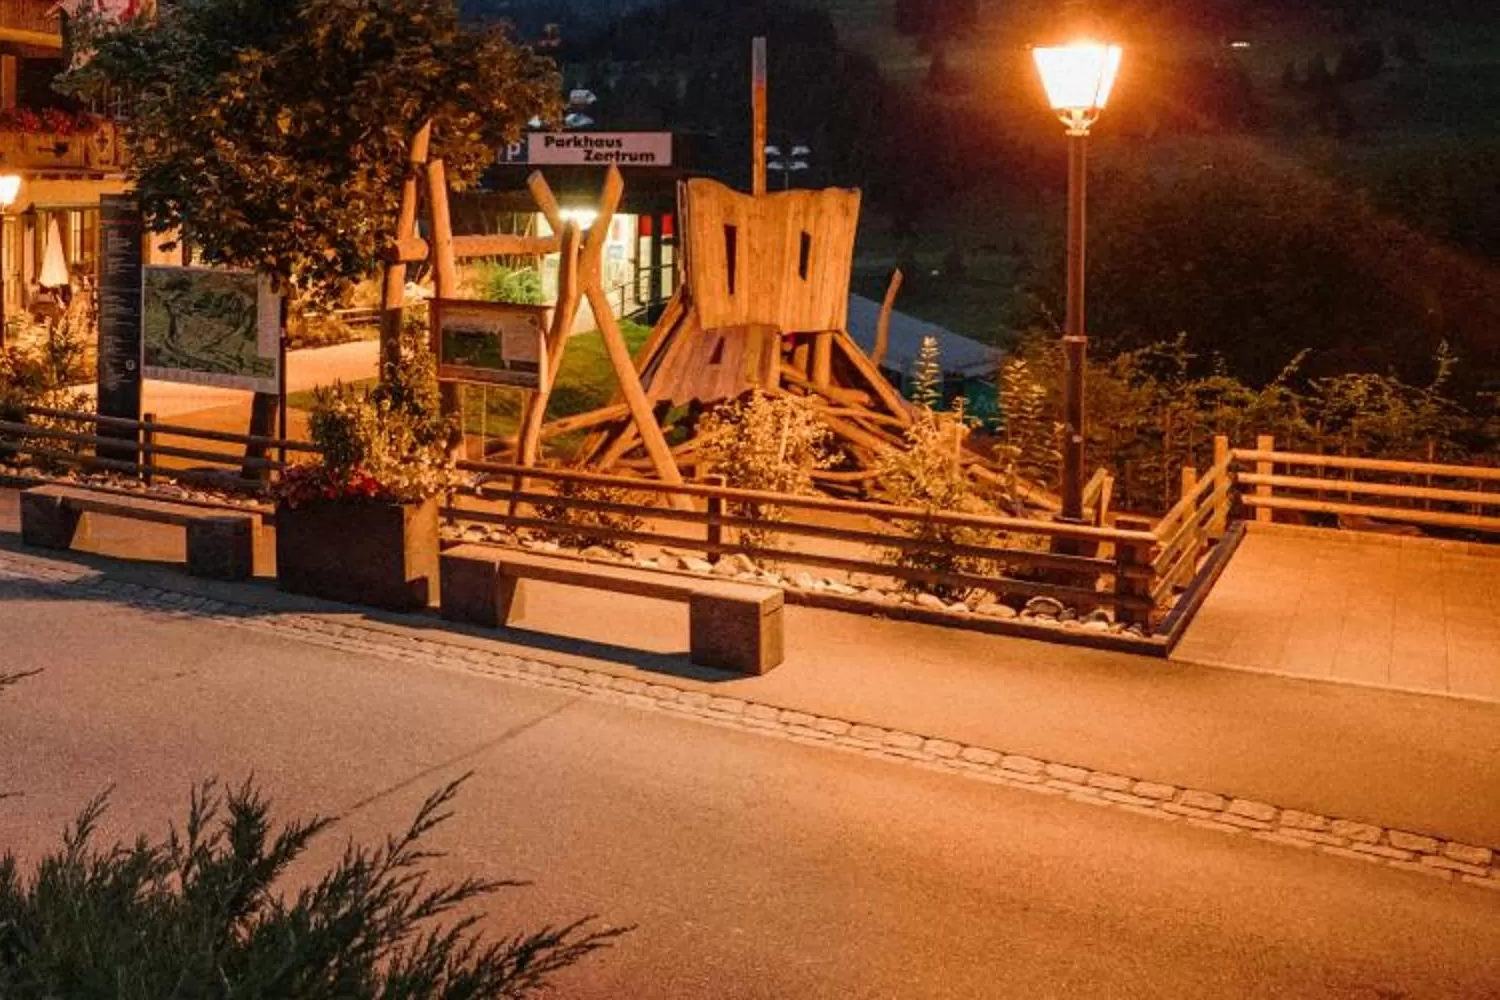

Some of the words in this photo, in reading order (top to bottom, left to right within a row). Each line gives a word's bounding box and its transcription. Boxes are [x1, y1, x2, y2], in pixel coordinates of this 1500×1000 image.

[545, 135, 623, 148] Parkhaus
[507, 143, 520, 160] P
[583, 149, 656, 162] Zentrum
